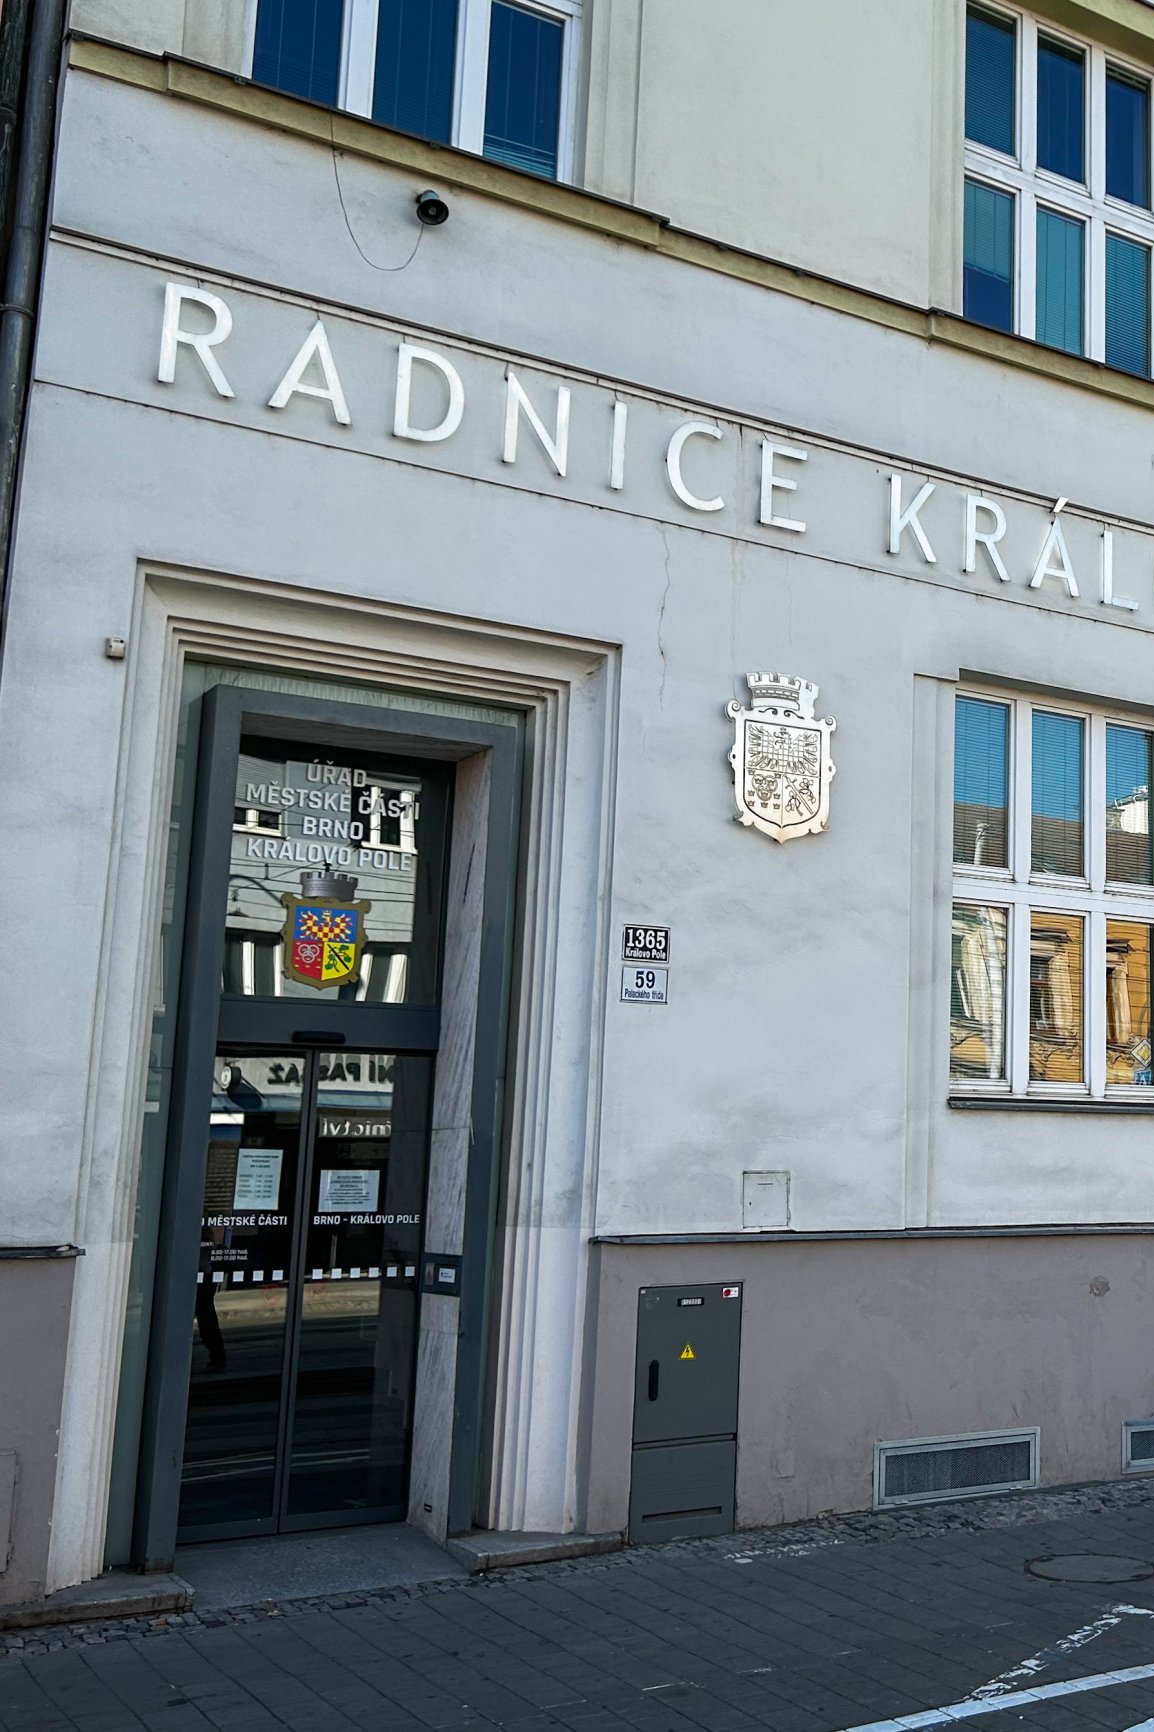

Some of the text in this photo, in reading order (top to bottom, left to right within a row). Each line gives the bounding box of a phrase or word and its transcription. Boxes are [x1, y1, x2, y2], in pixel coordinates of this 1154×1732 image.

[158, 282, 807, 532] RADNICE
[307, 758, 367, 788] ÚŘAD
[246, 780, 420, 820] MĚSTSKÉ ČÁSTI
[303, 815, 364, 840] BRNO
[247, 836, 412, 871] KRÁLOVO POLE
[627, 929, 666, 949] 1365
[625, 947, 666, 959] Královo Pole
[635, 970, 655, 989] 59
[207, 1214, 256, 1227] MĚSTSKÉ
[258, 1213, 288, 1226] ČÁSTI
[313, 1215, 341, 1225] BRNO
[350, 1213, 394, 1224] KRÁLOVO
[396, 1214, 420, 1224] POLE
